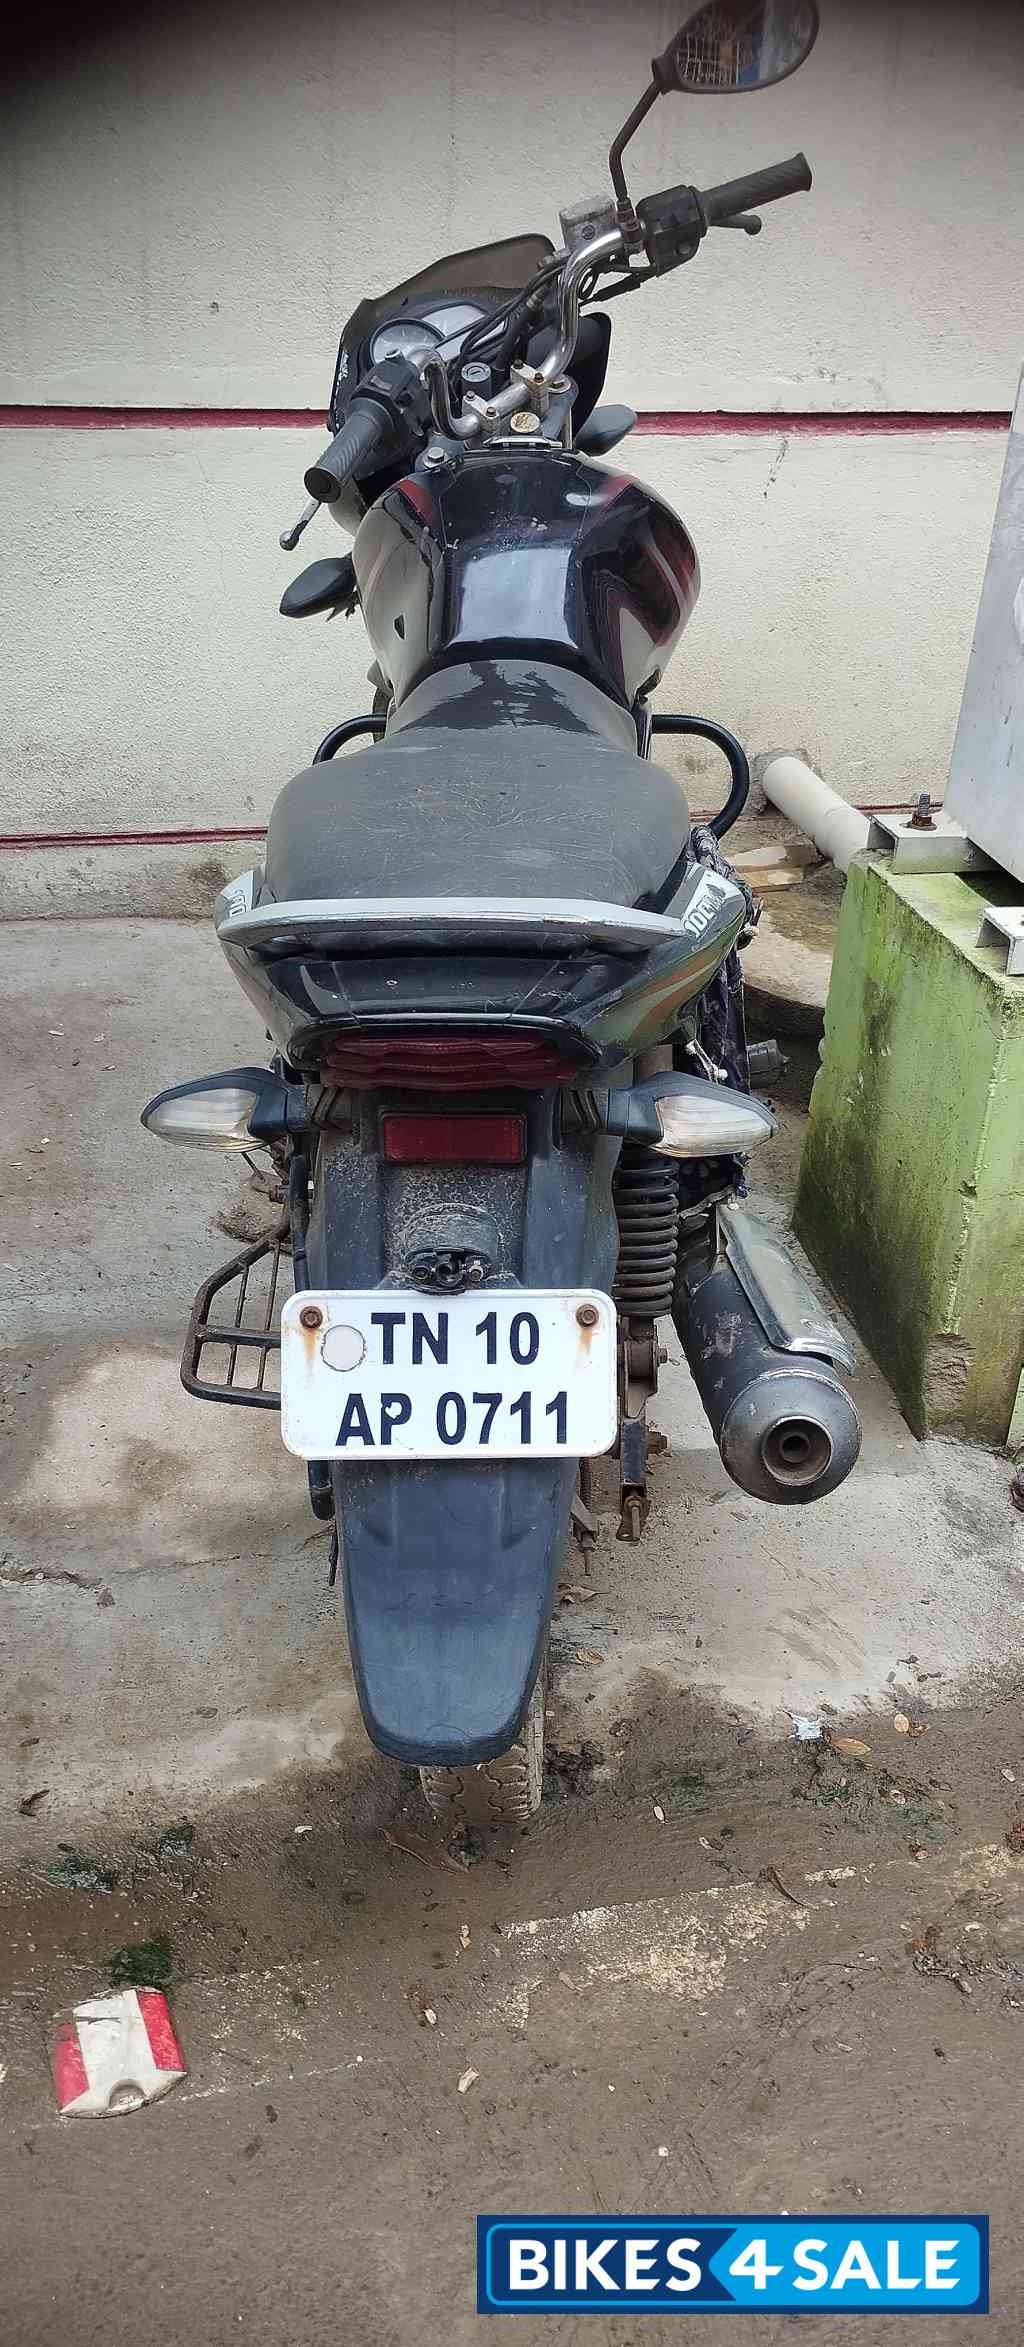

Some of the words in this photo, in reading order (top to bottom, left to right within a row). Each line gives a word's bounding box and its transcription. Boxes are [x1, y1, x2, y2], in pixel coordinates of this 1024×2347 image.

[370, 1312, 449, 1365] TN
[475, 1312, 540, 1366] 10
[335, 1392, 412, 1446] AP
[436, 1391, 568, 1445] 0711
